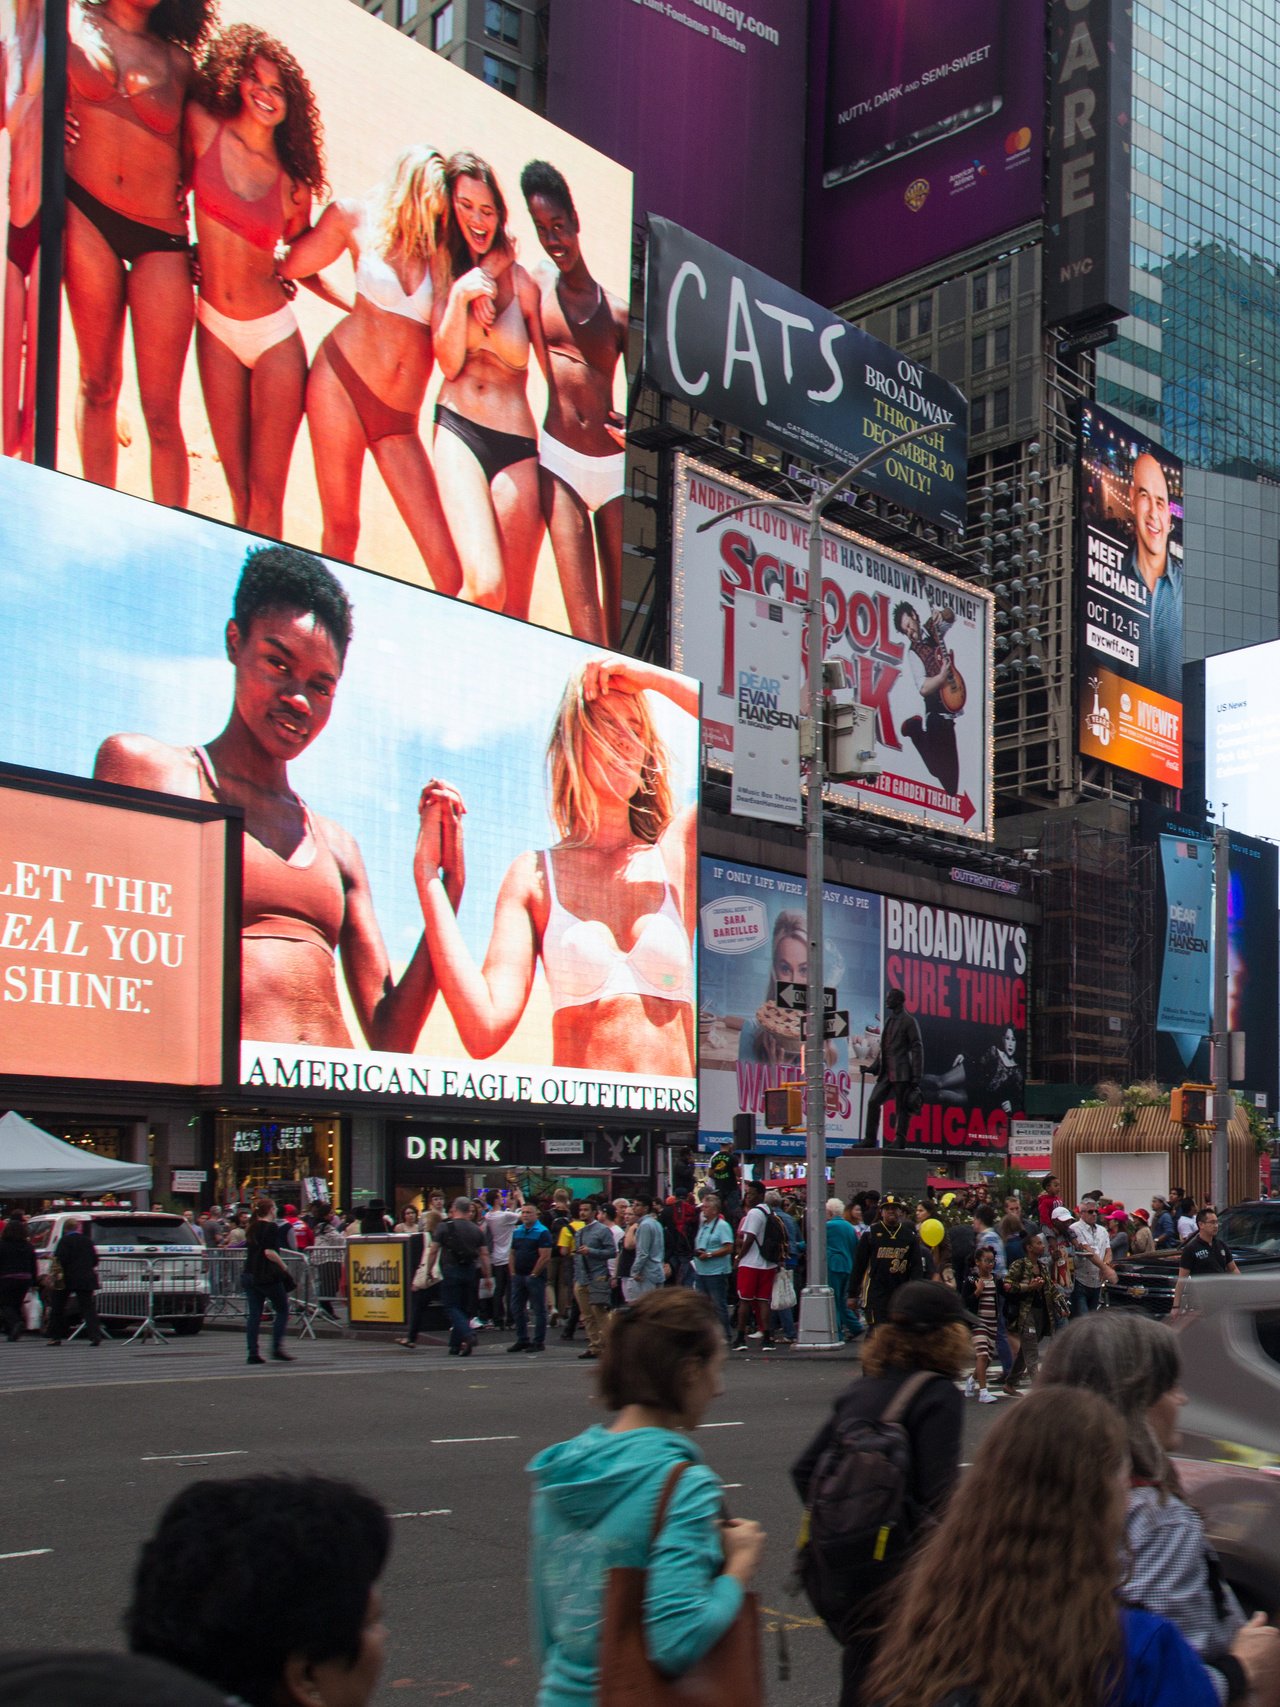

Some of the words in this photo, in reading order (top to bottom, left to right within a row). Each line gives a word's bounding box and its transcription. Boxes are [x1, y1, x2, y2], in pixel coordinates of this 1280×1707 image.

[710, 25, 746, 53] Theatre
[838, 99, 873, 125] NUTTY,
[874, 83, 904, 108] DARK
[904, 80, 920, 93] AND
[921, 44, 991, 85] SEMI-SWEET
[1060, 257, 1094, 282] NYC
[666, 260, 846, 406] CATS
[898, 360, 923, 390] ON
[864, 364, 953, 431] BROADWAY
[800, 435, 821, 450] Theatre
[885, 457, 931, 496] ONLY!
[939, 460, 955, 482] 30
[748, 504, 788, 540] LLOYD
[790, 520, 839, 563] WEBER
[841, 545, 864, 574] HAS
[866, 557, 924, 598] BROADWAY
[1087, 535, 1124, 572] MEET
[1087, 557, 1147, 606] MICHAEL!
[719, 528, 906, 666] SCHOOL
[1086, 600, 1109, 626] OCT
[1111, 612, 1140, 640] 12-15
[1091, 628, 1135, 662] nycwff.org
[738, 670, 781, 695] DEAR
[738, 686, 778, 710] EVAN
[1215, 701, 1226, 711] US
[1227, 699, 1246, 709] News
[738, 702, 799, 730] HANSEN
[738, 718, 747, 727] ON
[747, 719, 775, 732] BROADWAY
[1091, 714, 1111, 729] YEARS
[1137, 700, 1180, 742] NYCWFF
[736, 794, 798, 812] DearEvanHansen.com
[762, 790, 773, 799] Box
[774, 791, 798, 804] Theatre
[892, 778, 926, 803] GARDEN
[927, 789, 961, 814] THEATRE
[1166, 821, 1177, 831] YOU
[1231, 843, 1249, 855] YOU'VE
[1249, 848, 1261, 859] DIED
[85, 871, 173, 918] THE
[713, 867, 724, 879] IF
[726, 869, 752, 885] ONLY
[754, 875, 775, 890] LIFE
[776, 880, 803, 895] WERE
[842, 893, 854, 907] AS
[855, 897, 870, 909] PIE
[954, 870, 994, 887] OUTFRONT
[996, 880, 1018, 893] PRIME
[723, 914, 746, 925] SARA
[1169, 905, 1197, 924] DEAR
[1169, 919, 1194, 937] EVAN
[713, 924, 759, 938] BAREILLES
[886, 898, 1027, 976] BROADWAY'S
[1168, 933, 1208, 954] HANSEN
[105, 925, 186, 968] YOU
[887, 954, 951, 1017] SURE
[956, 968, 1026, 1031] THING
[247, 1056, 431, 1098] AMERICAN
[442, 1070, 532, 1103] EAGLE
[540, 1077, 696, 1114] OUTFITTERS
[883, 1099, 1027, 1148] CHICAG
[406, 1135, 501, 1162] DRINK
[876, 1246, 907, 1259] HEAT
[889, 1258, 908, 1274] 34
[352, 1259, 400, 1284] Beautiful
